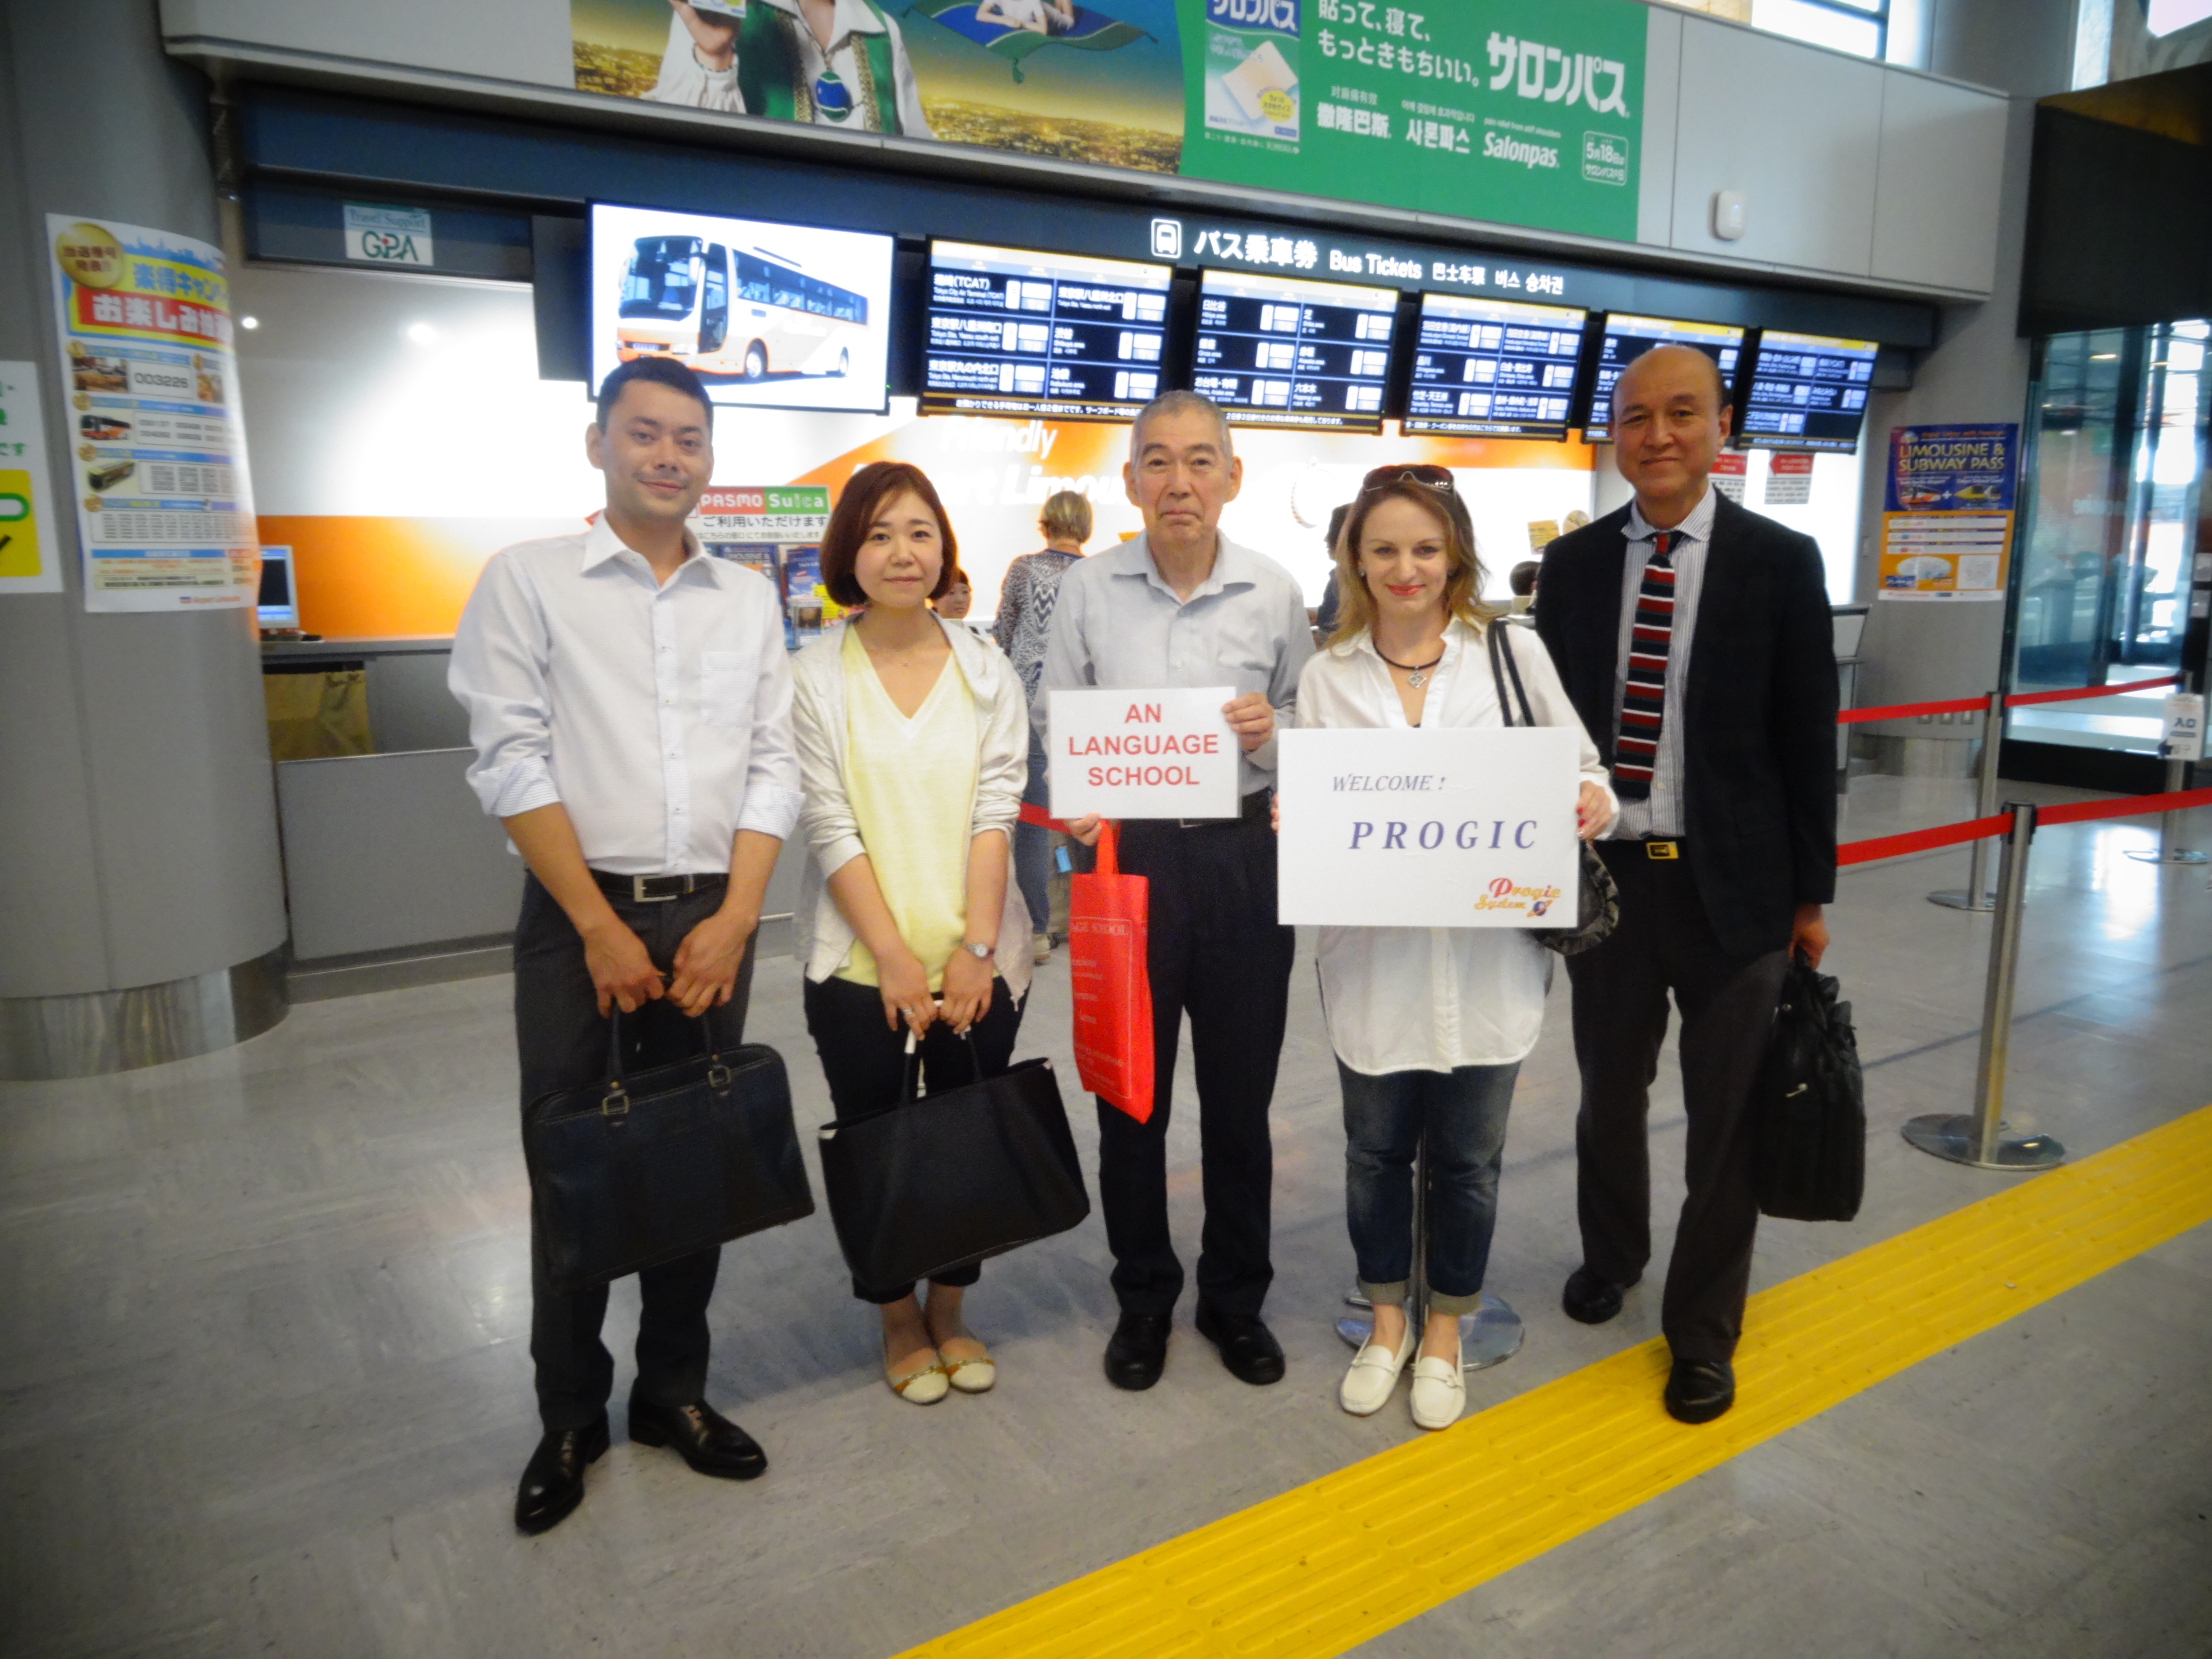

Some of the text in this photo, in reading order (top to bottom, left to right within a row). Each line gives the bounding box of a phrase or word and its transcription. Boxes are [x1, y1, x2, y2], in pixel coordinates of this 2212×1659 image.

[1318, 28, 1480, 88] もっときもちいい。
[1486, 31, 1627, 117] サロンパス
[1483, 131, 1558, 169] Salonpas
[1193, 230, 1318, 269] バス乗車券
[1329, 250, 1362, 273] Bus
[1365, 253, 1422, 280] Tickets
[1495, 269, 1521, 288] 버스
[1900, 443, 2005, 458] LIMOUSINE &
[1898, 457, 2005, 472] SUBWAY PASS
[701, 493, 825, 508] PASMO Suica
[703, 516, 828, 528] ご利用いただけます
[1124, 703, 1162, 723] AN
[1069, 734, 1219, 756] LANGUAGE
[1088, 766, 1200, 786] SCHOOL
[1331, 773, 1433, 792] WELCOME
[1348, 820, 1537, 849] PROGIC
